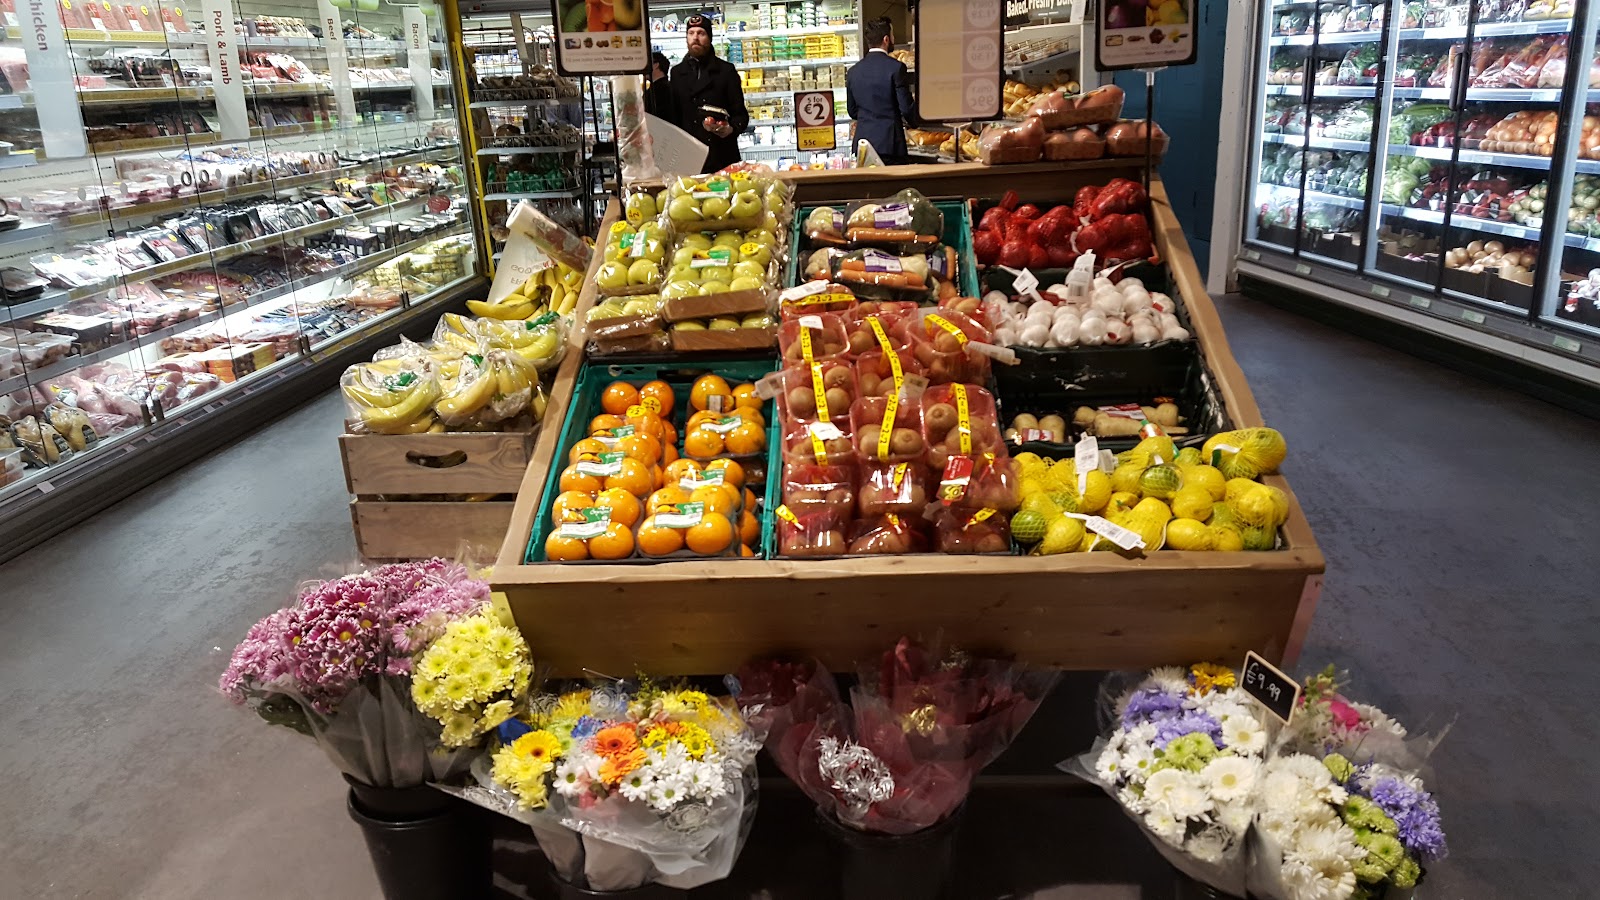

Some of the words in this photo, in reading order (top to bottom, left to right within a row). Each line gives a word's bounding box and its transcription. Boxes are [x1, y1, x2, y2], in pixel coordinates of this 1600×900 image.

[29, 0, 48, 50] hicken
[213, 10, 225, 37] Pork
[327, 18, 338, 41] Beef
[412, 23, 420, 49] Bacon
[218, 40, 226, 49] &
[219, 53, 232, 85] Lamb
[804, 102, 825, 120] €2
[1246, 662, 1281, 702] €9.99
